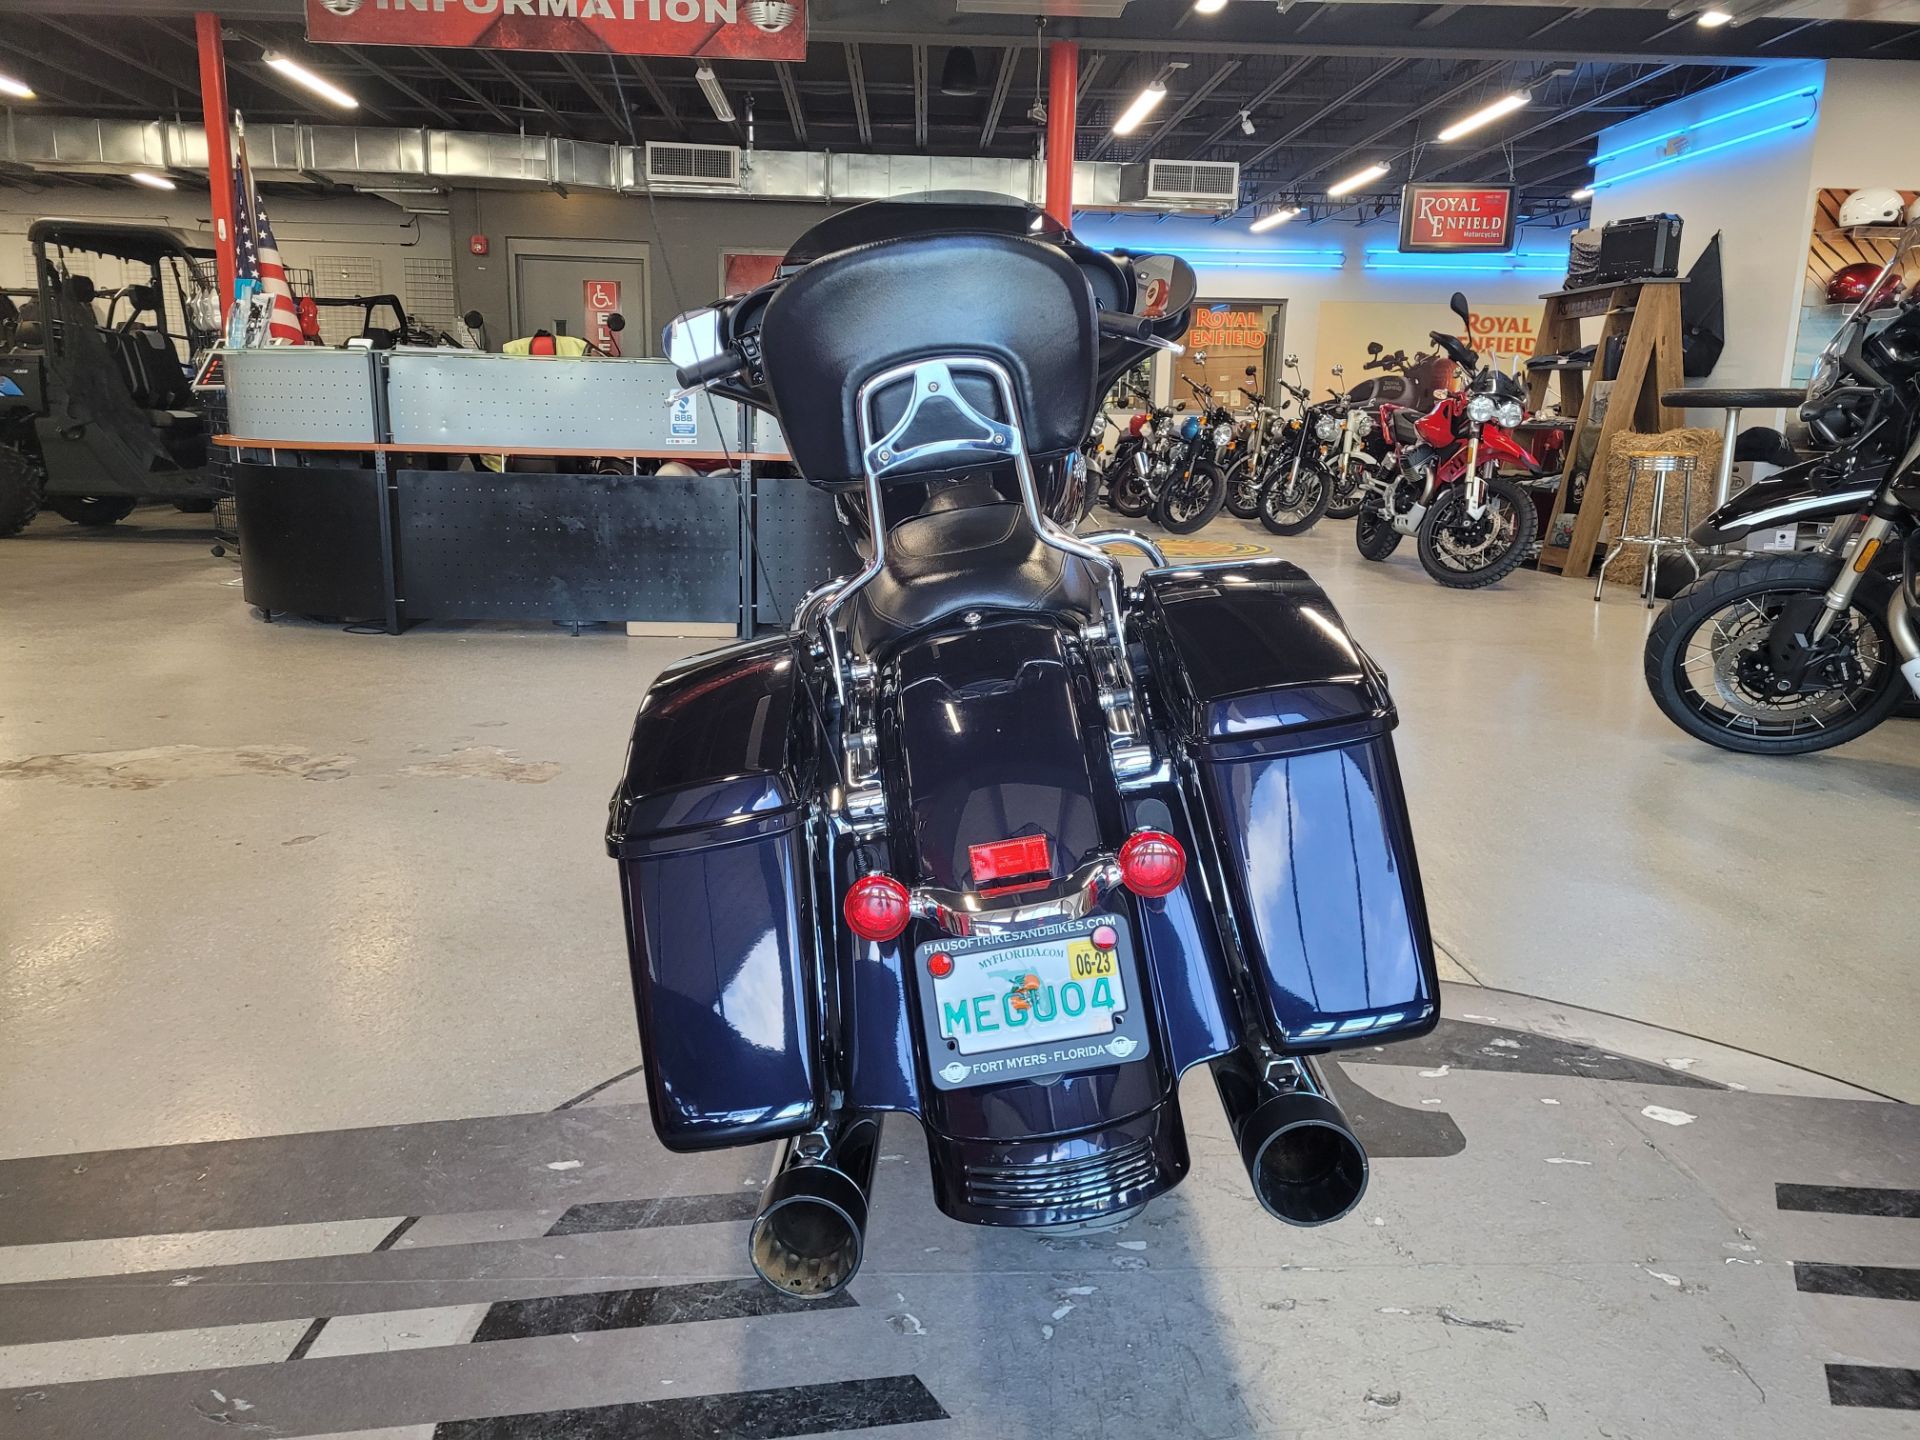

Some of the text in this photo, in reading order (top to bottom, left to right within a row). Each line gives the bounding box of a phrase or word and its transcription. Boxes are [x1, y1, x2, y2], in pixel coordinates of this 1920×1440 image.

[1418, 197, 1481, 225] ROYAL
[1431, 215, 1502, 237] ENFIELD
[1197, 308, 1259, 329] ROYAL
[1465, 313, 1533, 335] ROYAL
[1190, 331, 1266, 349] ENFIELD
[674, 414, 693, 422] BBB
[924, 916, 1116, 955] HAUSOFTRIKESANDBIKES.COM
[978, 947, 1065, 970] MYFLORIDA.COM
[1076, 951, 1111, 976] 06-23
[972, 1060, 1005, 1075] FORT
[1006, 1053, 1047, 1069] MYERS
[1054, 1045, 1106, 1064] FLORIDA
